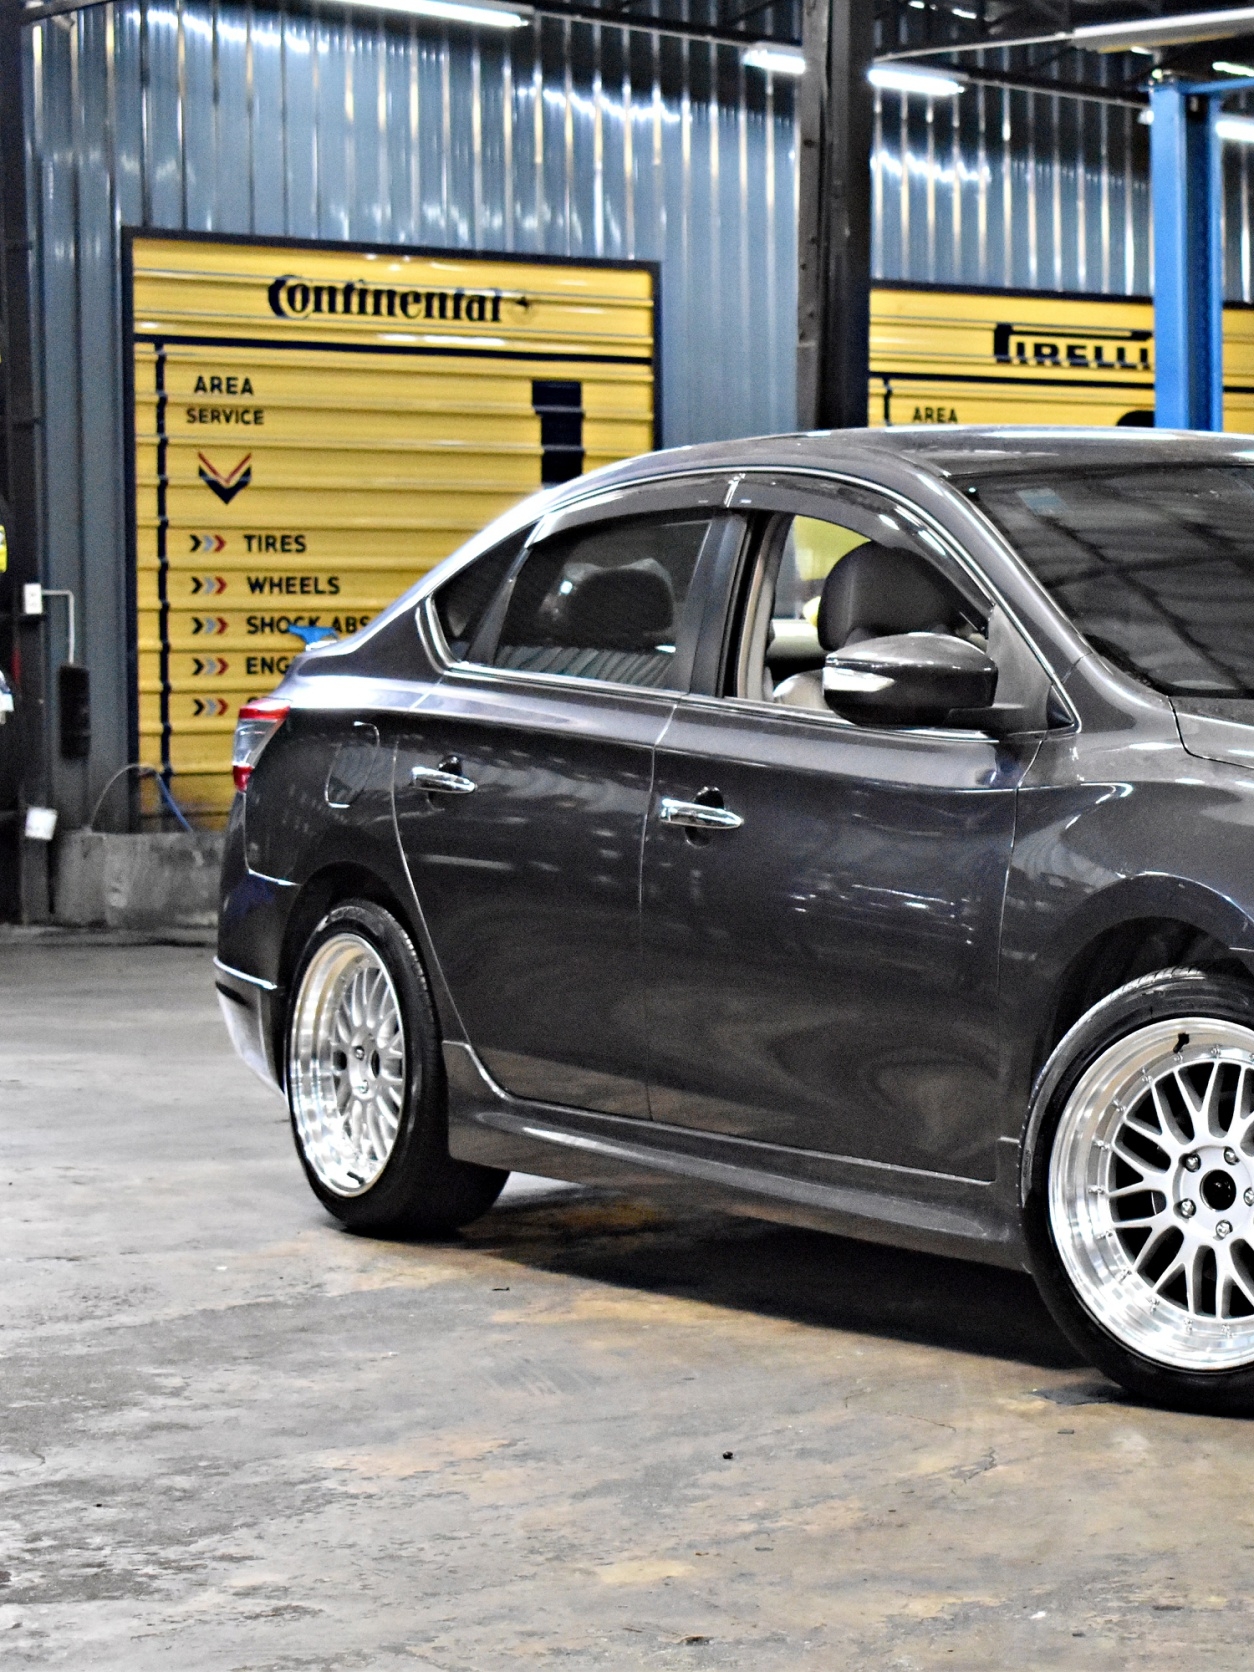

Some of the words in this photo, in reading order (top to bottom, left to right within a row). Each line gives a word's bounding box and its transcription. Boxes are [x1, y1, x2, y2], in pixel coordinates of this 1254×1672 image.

[267, 274, 502, 322] Continental
[994, 322, 1153, 369] PIRELLI
[194, 375, 253, 395] AREA
[186, 407, 264, 426] SERVICE
[912, 406, 958, 424] AREA
[243, 534, 306, 553] TIRES
[246, 576, 340, 595] WHEELS
[246, 656, 296, 675] ENG
